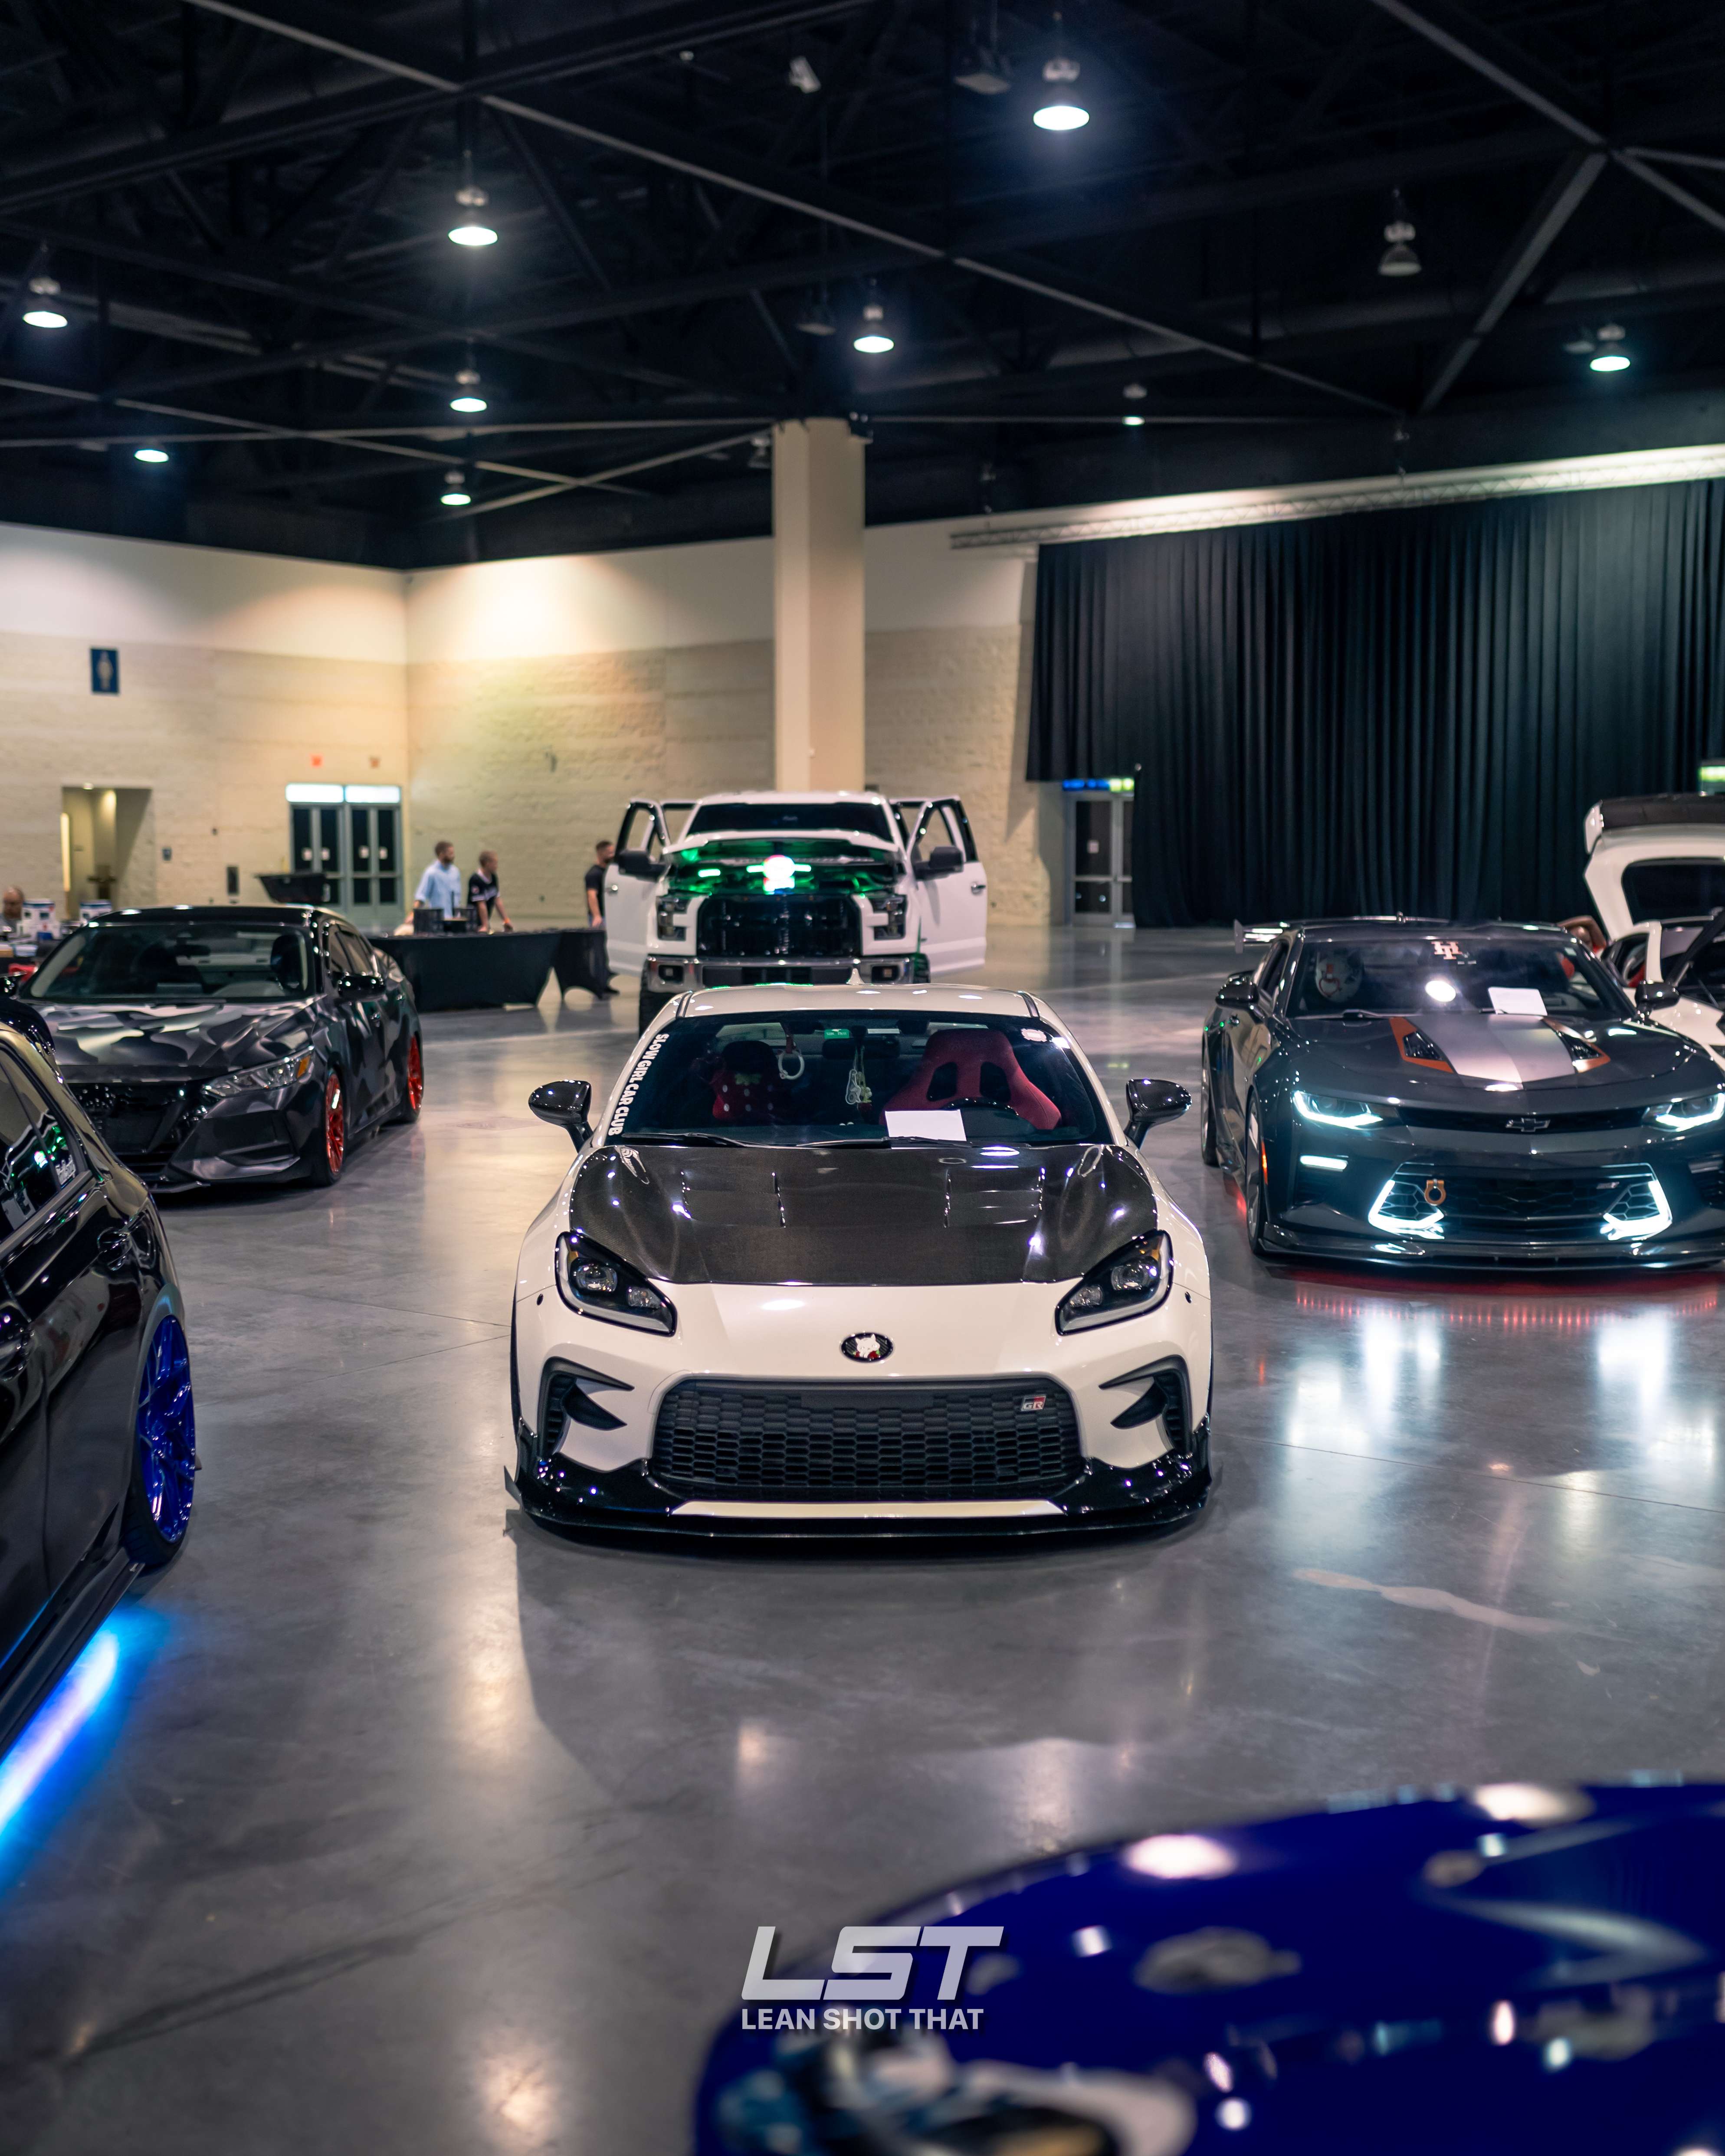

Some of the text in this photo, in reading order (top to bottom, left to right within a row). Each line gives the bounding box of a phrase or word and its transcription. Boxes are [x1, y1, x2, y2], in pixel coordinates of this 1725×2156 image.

[608, 1033, 669, 1136] SLOW GIRL CAR CLUB
